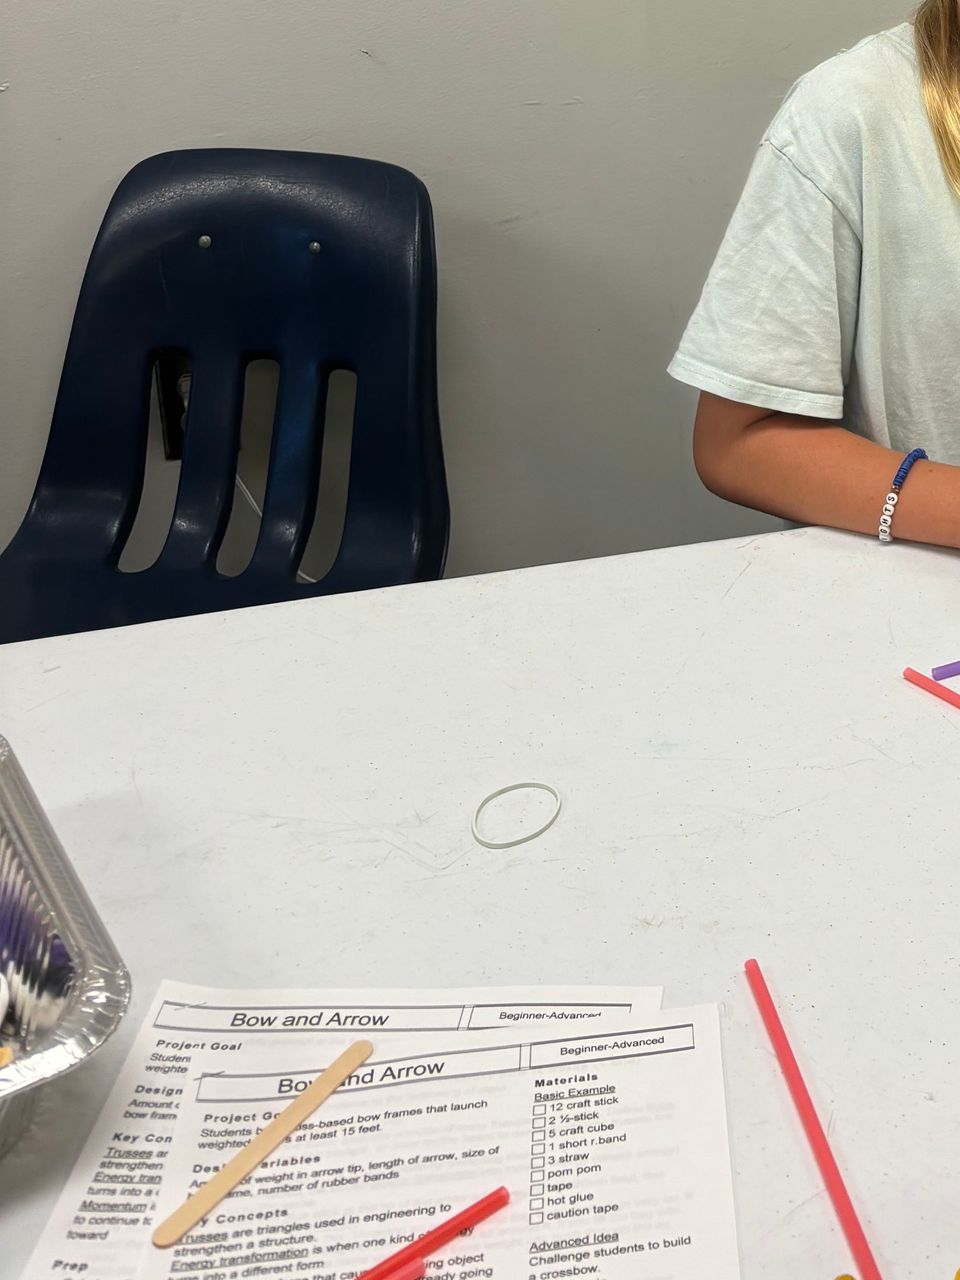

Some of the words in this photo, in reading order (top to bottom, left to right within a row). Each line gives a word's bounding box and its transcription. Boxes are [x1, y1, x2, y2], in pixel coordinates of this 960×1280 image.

[230, 1013, 277, 1027] Bow
[282, 1012, 320, 1026] and
[326, 1012, 390, 1026] Arrow
[210, 1041, 243, 1052] Goal
[560, 1036, 665, 1056] Beginner-Advanced
[379, 1062, 445, 1081] Arrow
[534, 1073, 598, 1087] Materials
[135, 1085, 183, 1096] Design
[534, 1090, 566, 1104] Basic
[569, 1084, 616, 1100] Example
[357, 1114, 380, 1124] bow
[384, 1106, 423, 1120] frames
[426, 1104, 448, 1114] that
[450, 1099, 488, 1111] launch
[550, 1102, 563, 1113] 12
[566, 1098, 591, 1110] craft
[594, 1095, 619, 1106] stick
[123, 1111, 148, 1119] bow
[203, 1114, 257, 1123] Project
[548, 1116, 556, 1125] 2
[200, 1127, 252, 1138] Students
[296, 1134, 306, 1143] at
[309, 1131, 337, 1142] least
[342, 1126, 356, 1136] 15
[549, 1129, 556, 1138] 5
[559, 1126, 584, 1137] craft
[587, 1122, 615, 1133] cube
[112, 1132, 139, 1144] Key
[559, 1138, 588, 1150] short
[591, 1132, 627, 1146] r.band
[104, 1147, 153, 1158] Trusses
[548, 1156, 555, 1165] 3
[559, 1151, 590, 1164] straw
[100, 1161, 163, 1171] strengthen
[255, 1170, 293, 1186] weight
[297, 1168, 307, 1178] in
[310, 1165, 345, 1177] arrow
[348, 1164, 365, 1176] tip,
[368, 1156, 405, 1170] length
[408, 1155, 419, 1165] of
[422, 1152, 458, 1164] arrow,
[462, 1148, 485, 1159] size
[488, 1145, 500, 1155] of
[261, 1155, 321, 1169] ariables
[92, 1172, 135, 1184] Energy
[547, 1168, 573, 1180] pom
[576, 1163, 602, 1176] pom
[257, 1183, 303, 1196] number
[307, 1180, 318, 1190] of
[321, 1176, 359, 1189] rubber
[363, 1171, 400, 1184] bands
[547, 1182, 573, 1194] tape
[120, 1187, 142, 1196] into
[547, 1195, 566, 1206] hot
[569, 1192, 594, 1205] glue
[79, 1200, 147, 1212] Momentum
[547, 1205, 590, 1221] caution
[593, 1202, 619, 1215] tape
[88, 1216, 139, 1226] continue
[216, 1208, 289, 1225] Concepts
[231, 1228, 254, 1239] are
[257, 1218, 310, 1235] triangles
[315, 1216, 345, 1229] used
[348, 1214, 359, 1225] in
[363, 1205, 436, 1223] engineering
[440, 1203, 451, 1213] to
[173, 1241, 242, 1258] strengthen
[246, 1241, 254, 1249] a
[529, 1234, 590, 1254] Advanced
[593, 1231, 619, 1245] Idea
[170, 1259, 217, 1274] Energy
[219, 1248, 309, 1268] transformation
[313, 1244, 322, 1254] is
[326, 1240, 359, 1253] when
[363, 1238, 386, 1249] one
[389, 1231, 414, 1244] kind
[529, 1251, 590, 1267] Challenge
[593, 1243, 645, 1258] students
[648, 1240, 660, 1250] to
[663, 1235, 692, 1248] build
[52, 1260, 88, 1272] Prep
[447, 1252, 484, 1267] object
[228, 1271, 238, 1279] a
[241, 1262, 293, 1278] different
[296, 1260, 325, 1271] form
[459, 1266, 493, 1280] going
